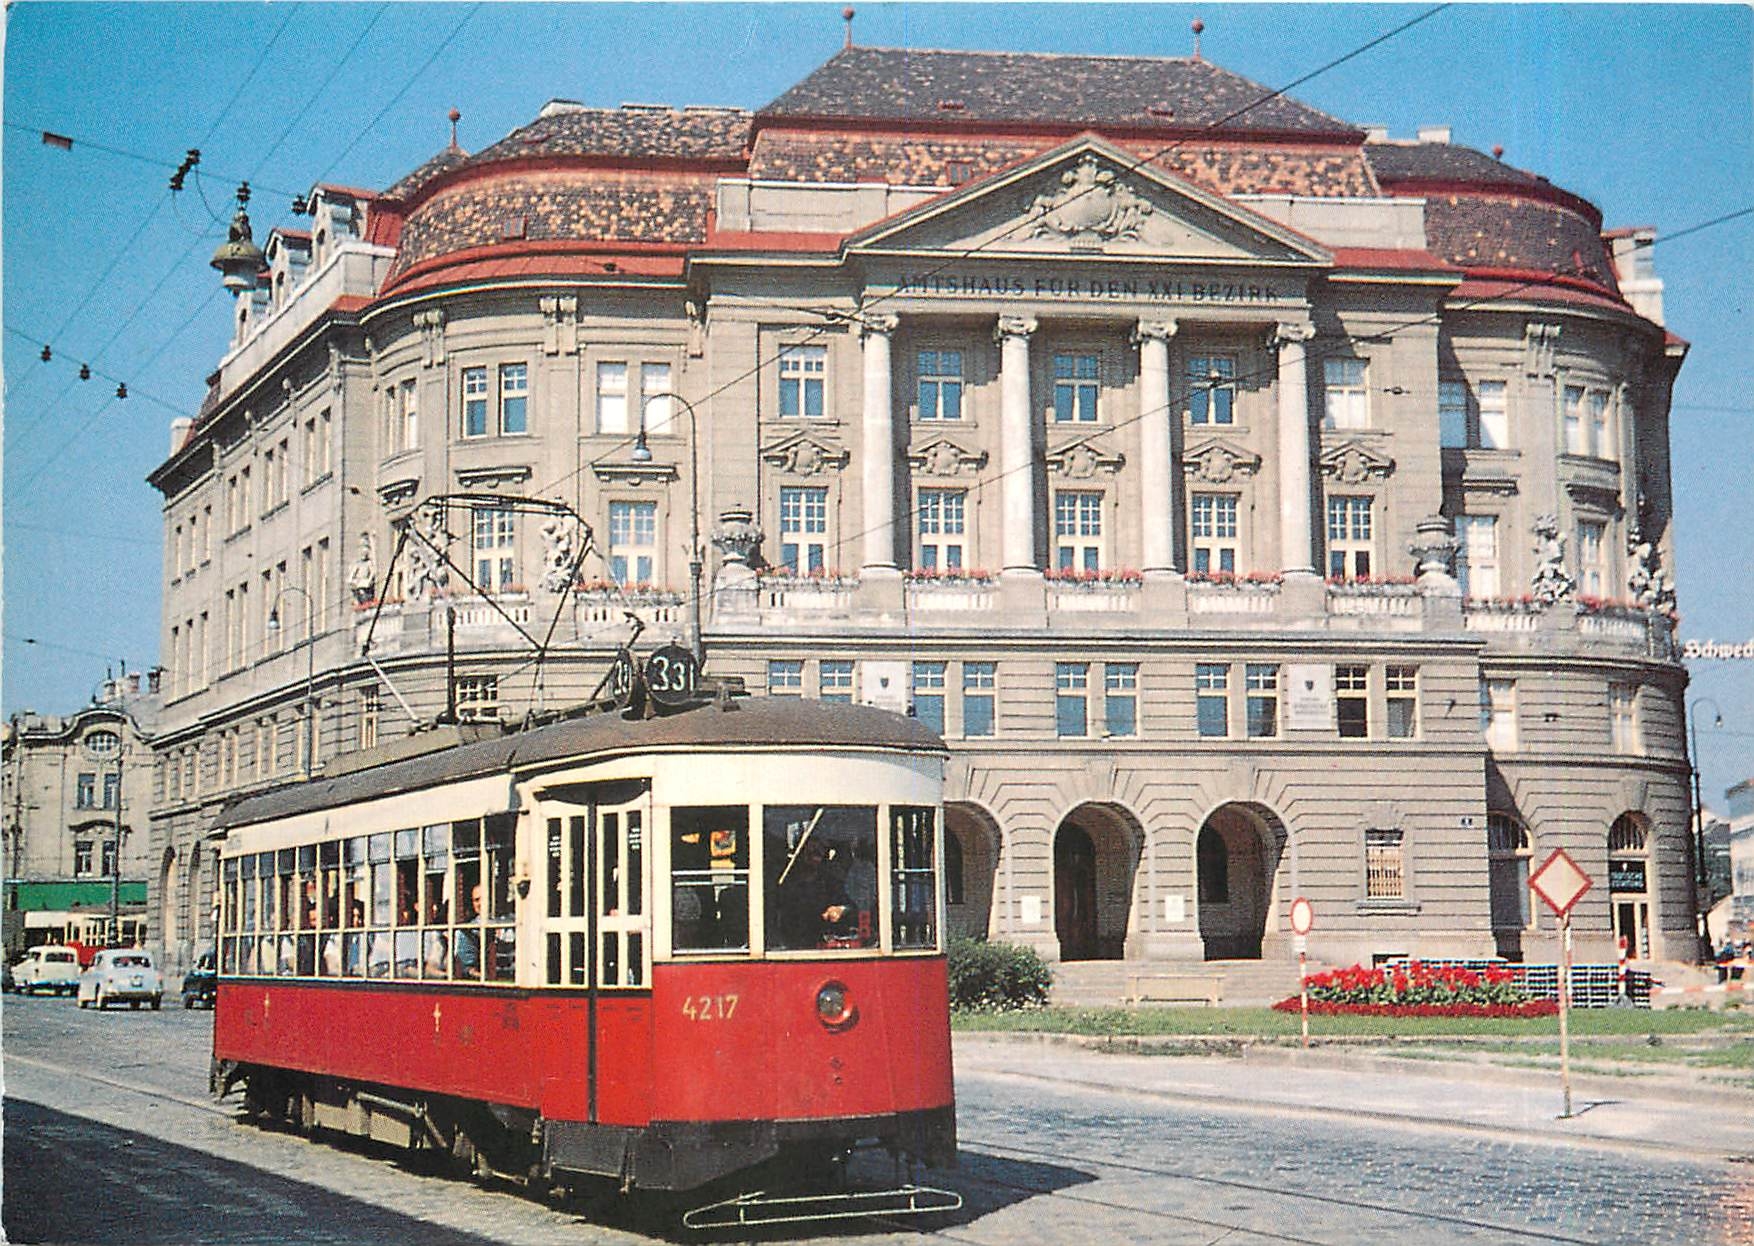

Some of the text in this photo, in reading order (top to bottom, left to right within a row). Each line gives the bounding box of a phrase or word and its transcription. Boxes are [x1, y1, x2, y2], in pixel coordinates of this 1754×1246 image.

[898, 274, 1025, 296] AMTSHAUS
[1089, 279, 1138, 299] DEN
[1192, 281, 1280, 304] BEZIRK
[682, 994, 739, 1021] 4217
